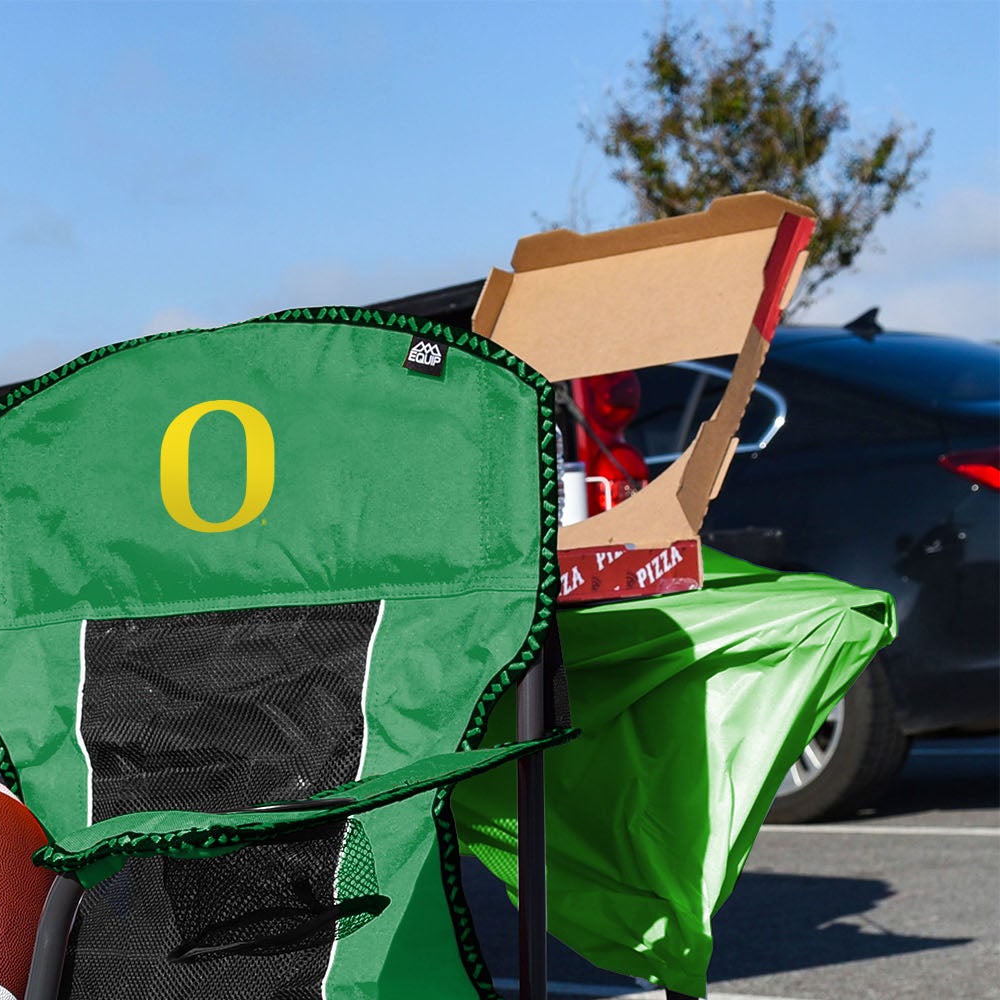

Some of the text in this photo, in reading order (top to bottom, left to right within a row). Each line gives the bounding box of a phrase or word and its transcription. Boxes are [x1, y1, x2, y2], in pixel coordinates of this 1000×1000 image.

[408, 350, 441, 366] EQUIP
[160, 400, 275, 532] O
[635, 546, 683, 588] PIZZA
